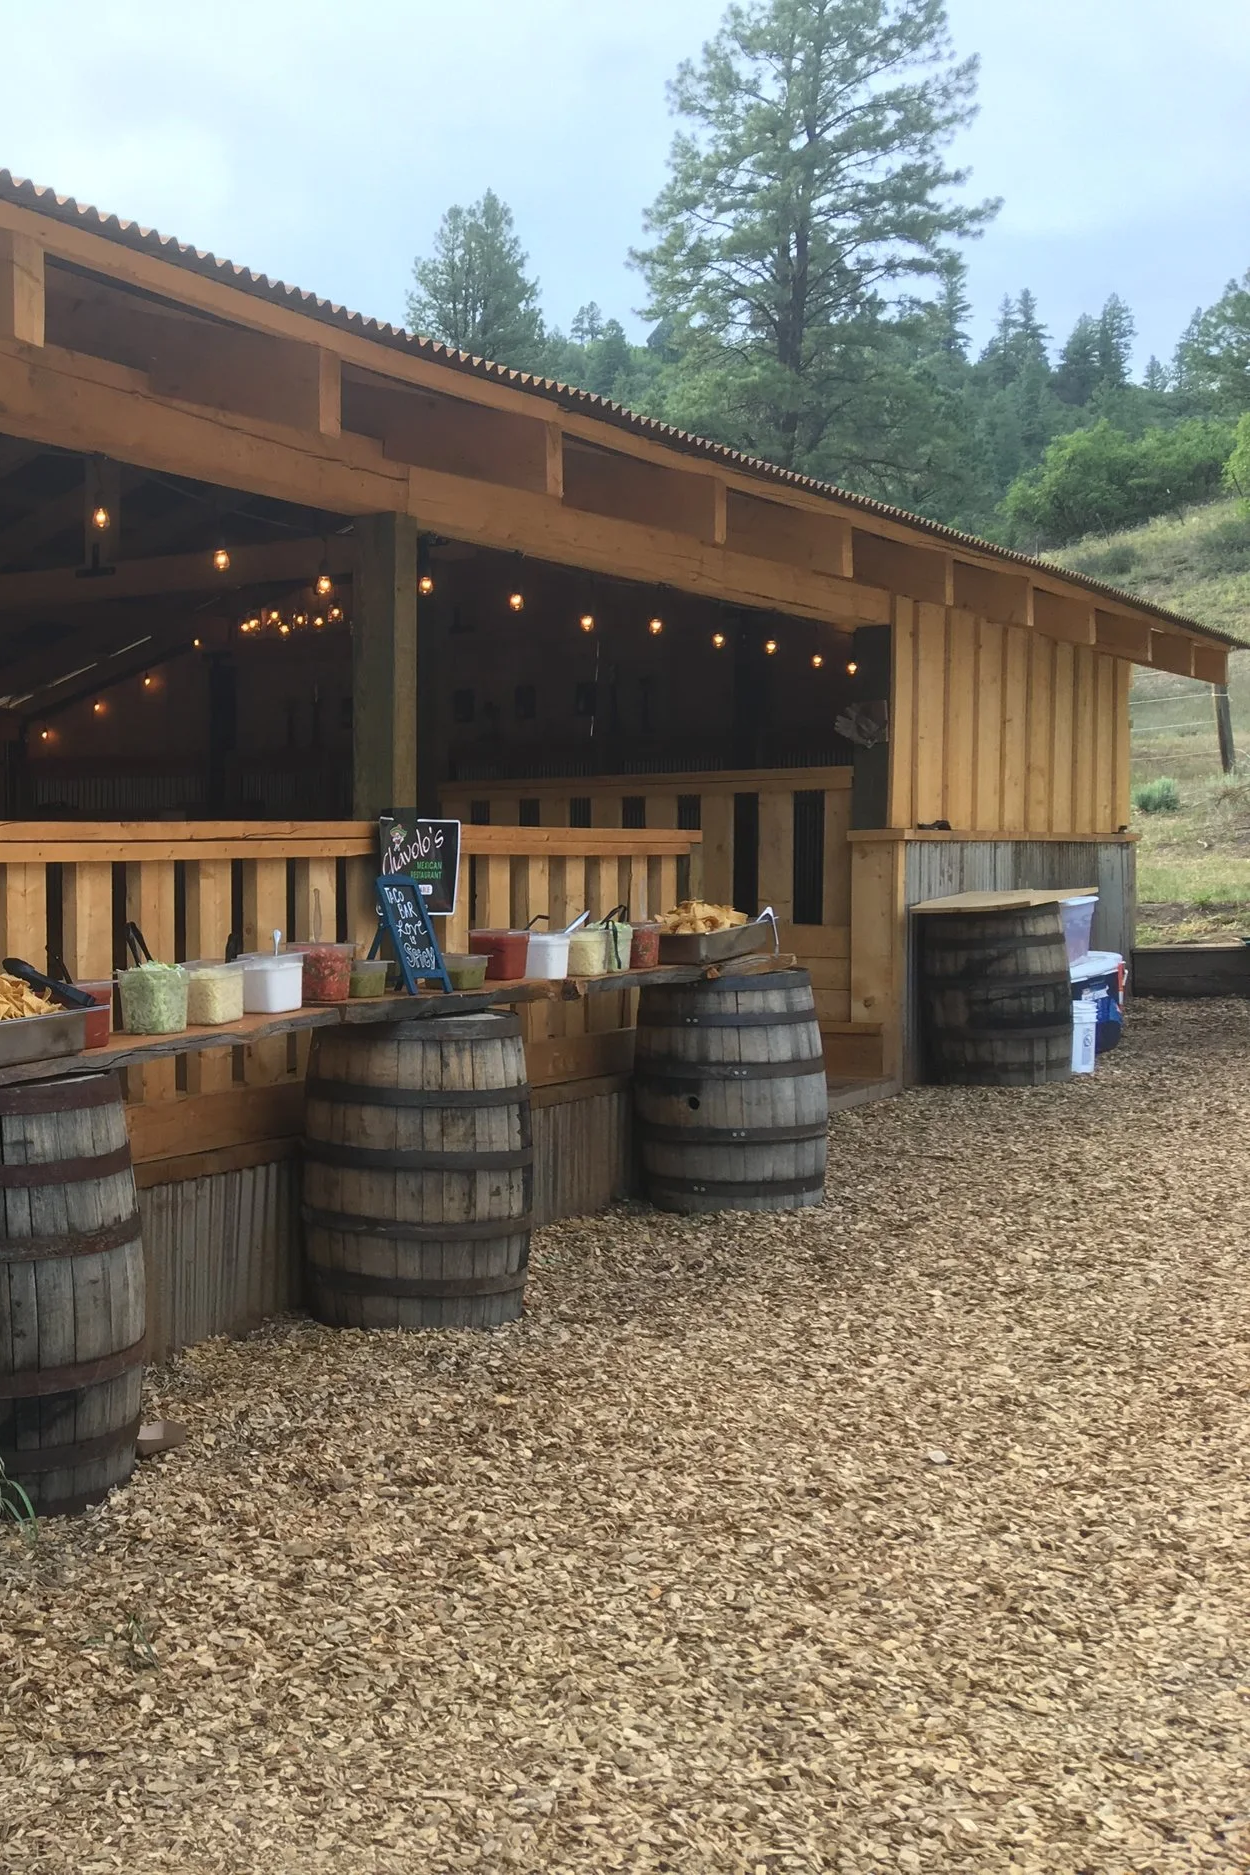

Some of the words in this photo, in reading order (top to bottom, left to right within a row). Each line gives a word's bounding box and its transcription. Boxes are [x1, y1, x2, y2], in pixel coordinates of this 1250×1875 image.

[416, 861, 442, 870] MEXICAN
[410, 870, 442, 879] RESTAURANT
[398, 903, 417, 919] BAR
